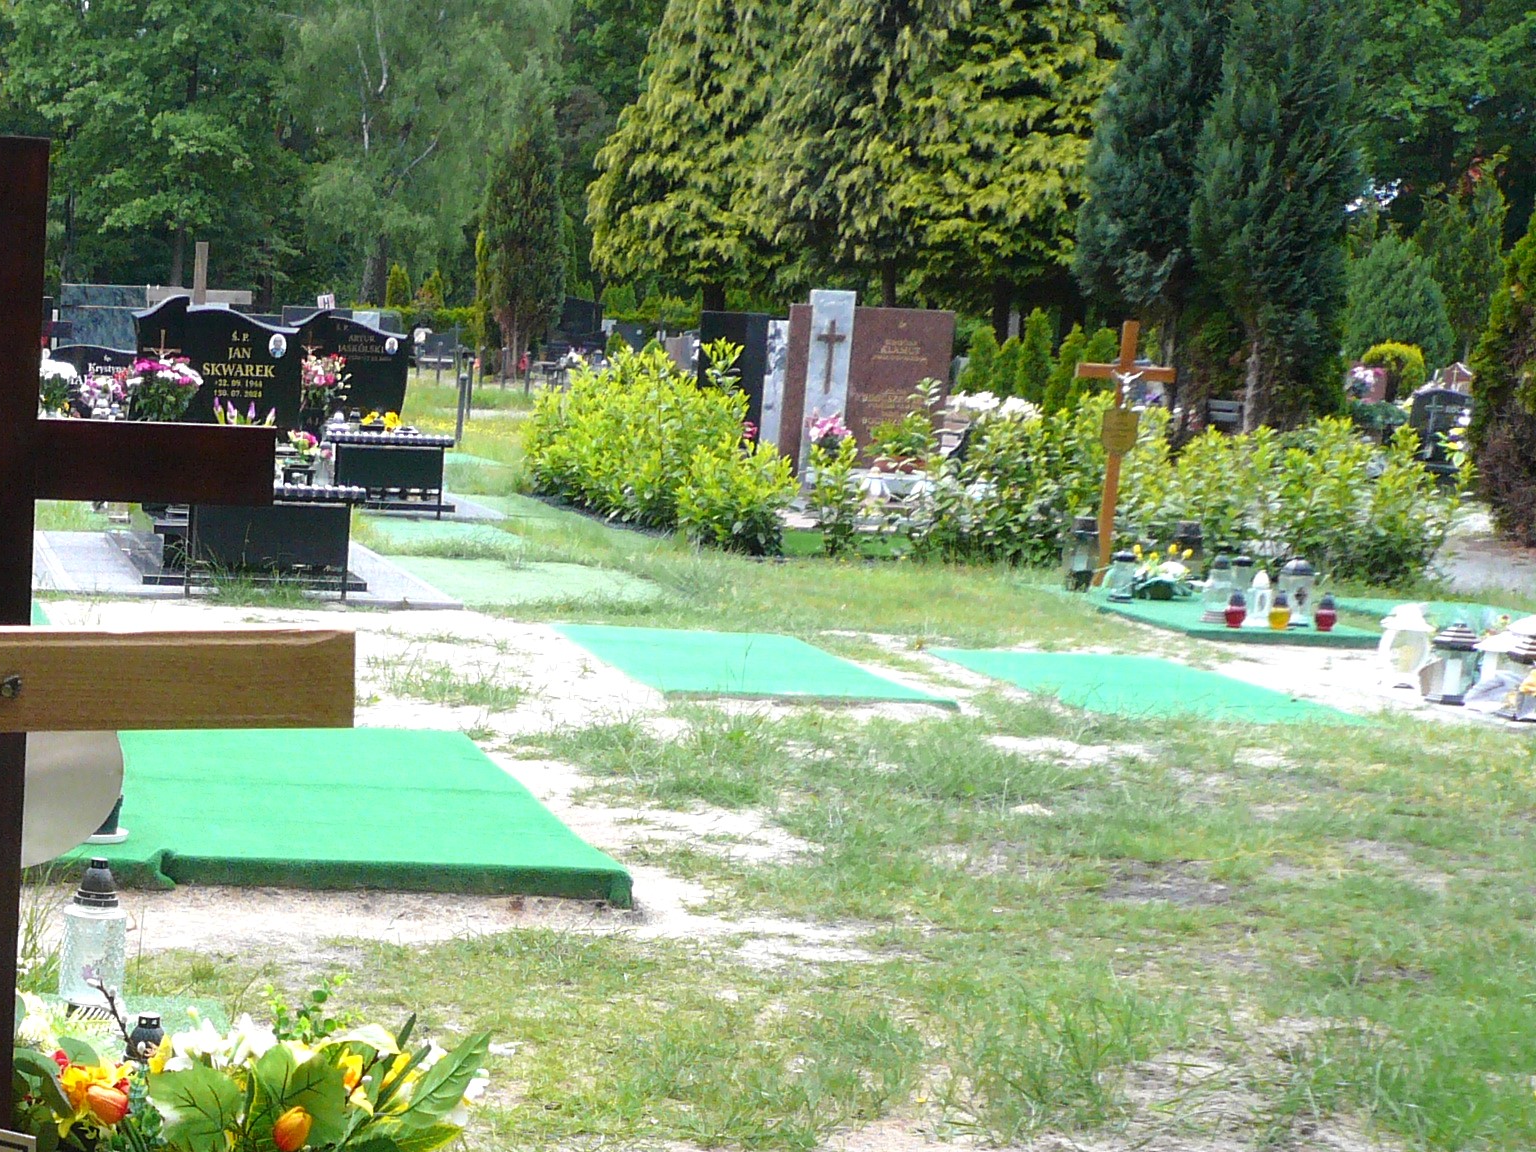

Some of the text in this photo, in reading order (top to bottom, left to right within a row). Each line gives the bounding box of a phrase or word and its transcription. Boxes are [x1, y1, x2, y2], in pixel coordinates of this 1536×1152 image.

[228, 347, 252, 360] JAN
[88, 362, 123, 375] Krystyn
[202, 362, 275, 378] SKWAREK
